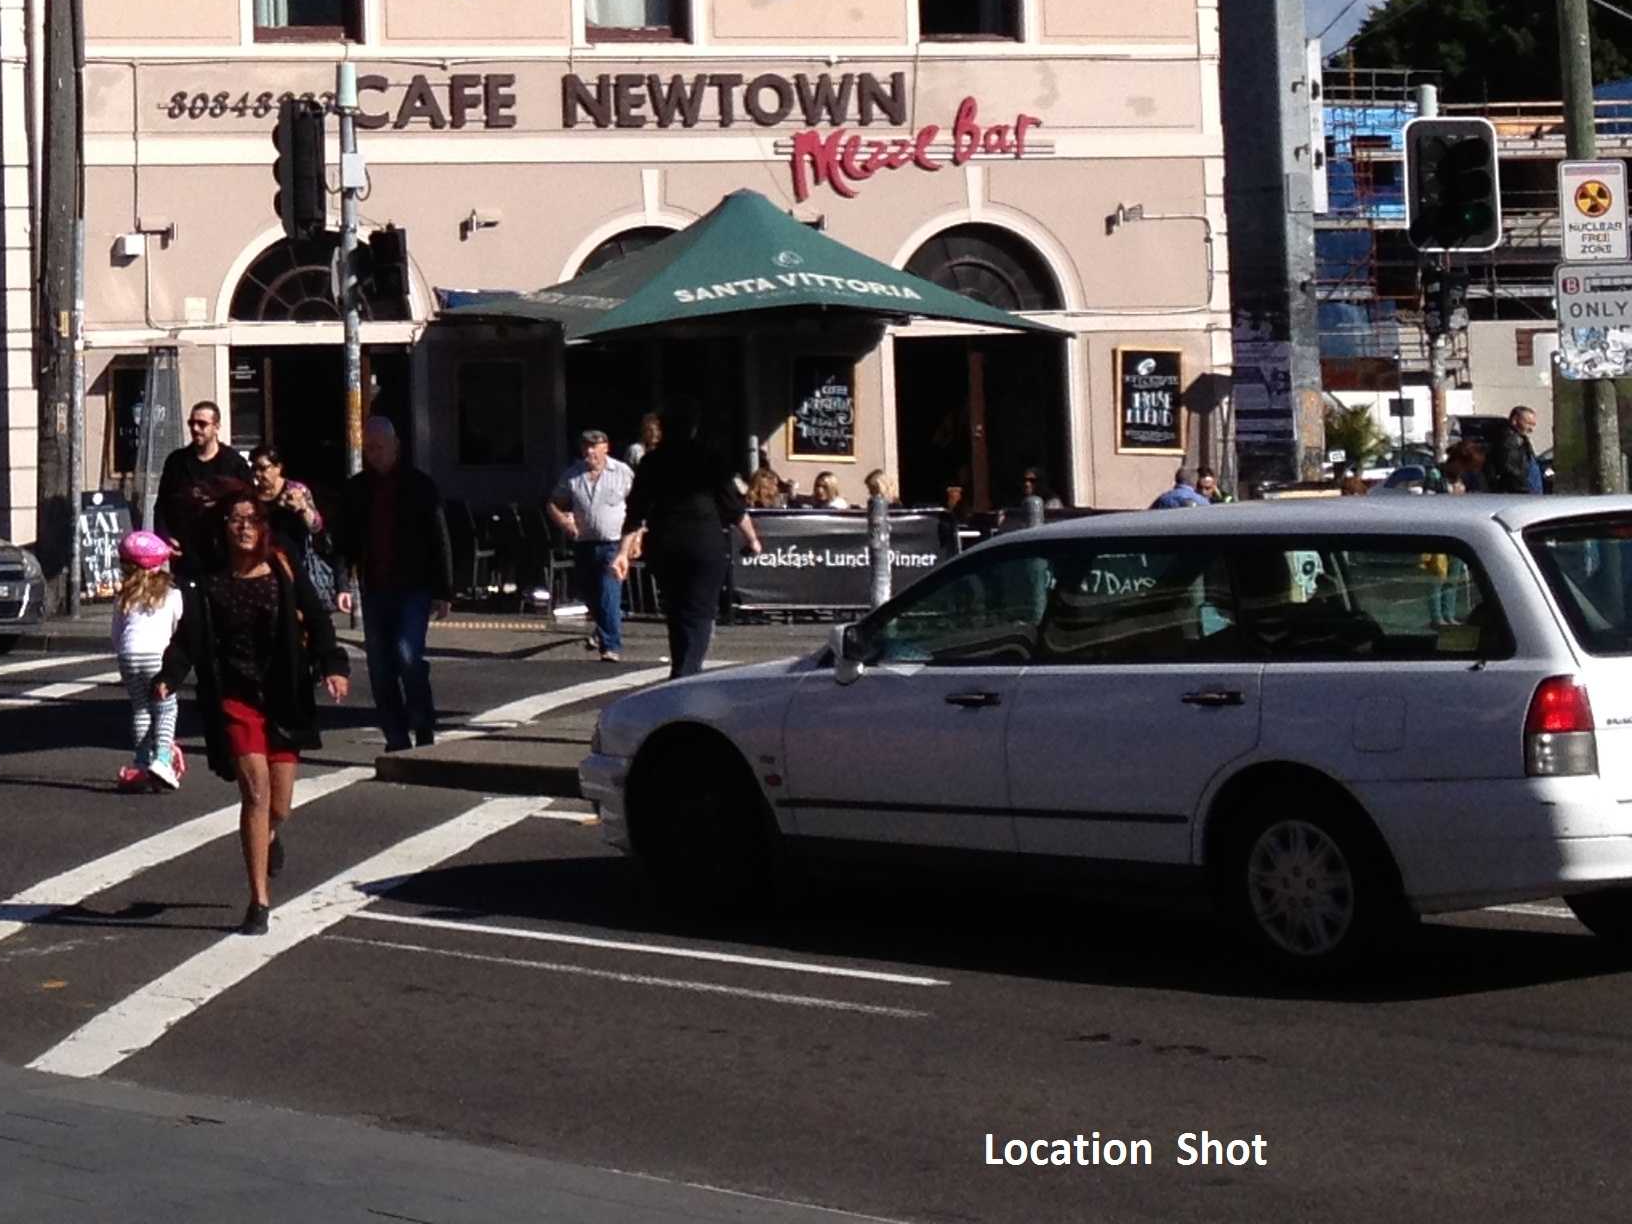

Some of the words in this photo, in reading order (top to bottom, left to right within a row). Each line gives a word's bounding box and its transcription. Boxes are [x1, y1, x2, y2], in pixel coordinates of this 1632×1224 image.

[167, 91, 338, 119] 80848
[355, 74, 516, 129] CAFE
[562, 71, 906, 128] NEWTOWN
[789, 124, 943, 204] Mezze
[1569, 222, 1622, 232] NUCLEAR
[1582, 233, 1610, 242] FREE
[1581, 245, 1612, 254] ZONE
[674, 277, 777, 302] SANTA
[776, 272, 922, 300] VITTORIA
[1569, 301, 1628, 318] ONLY
